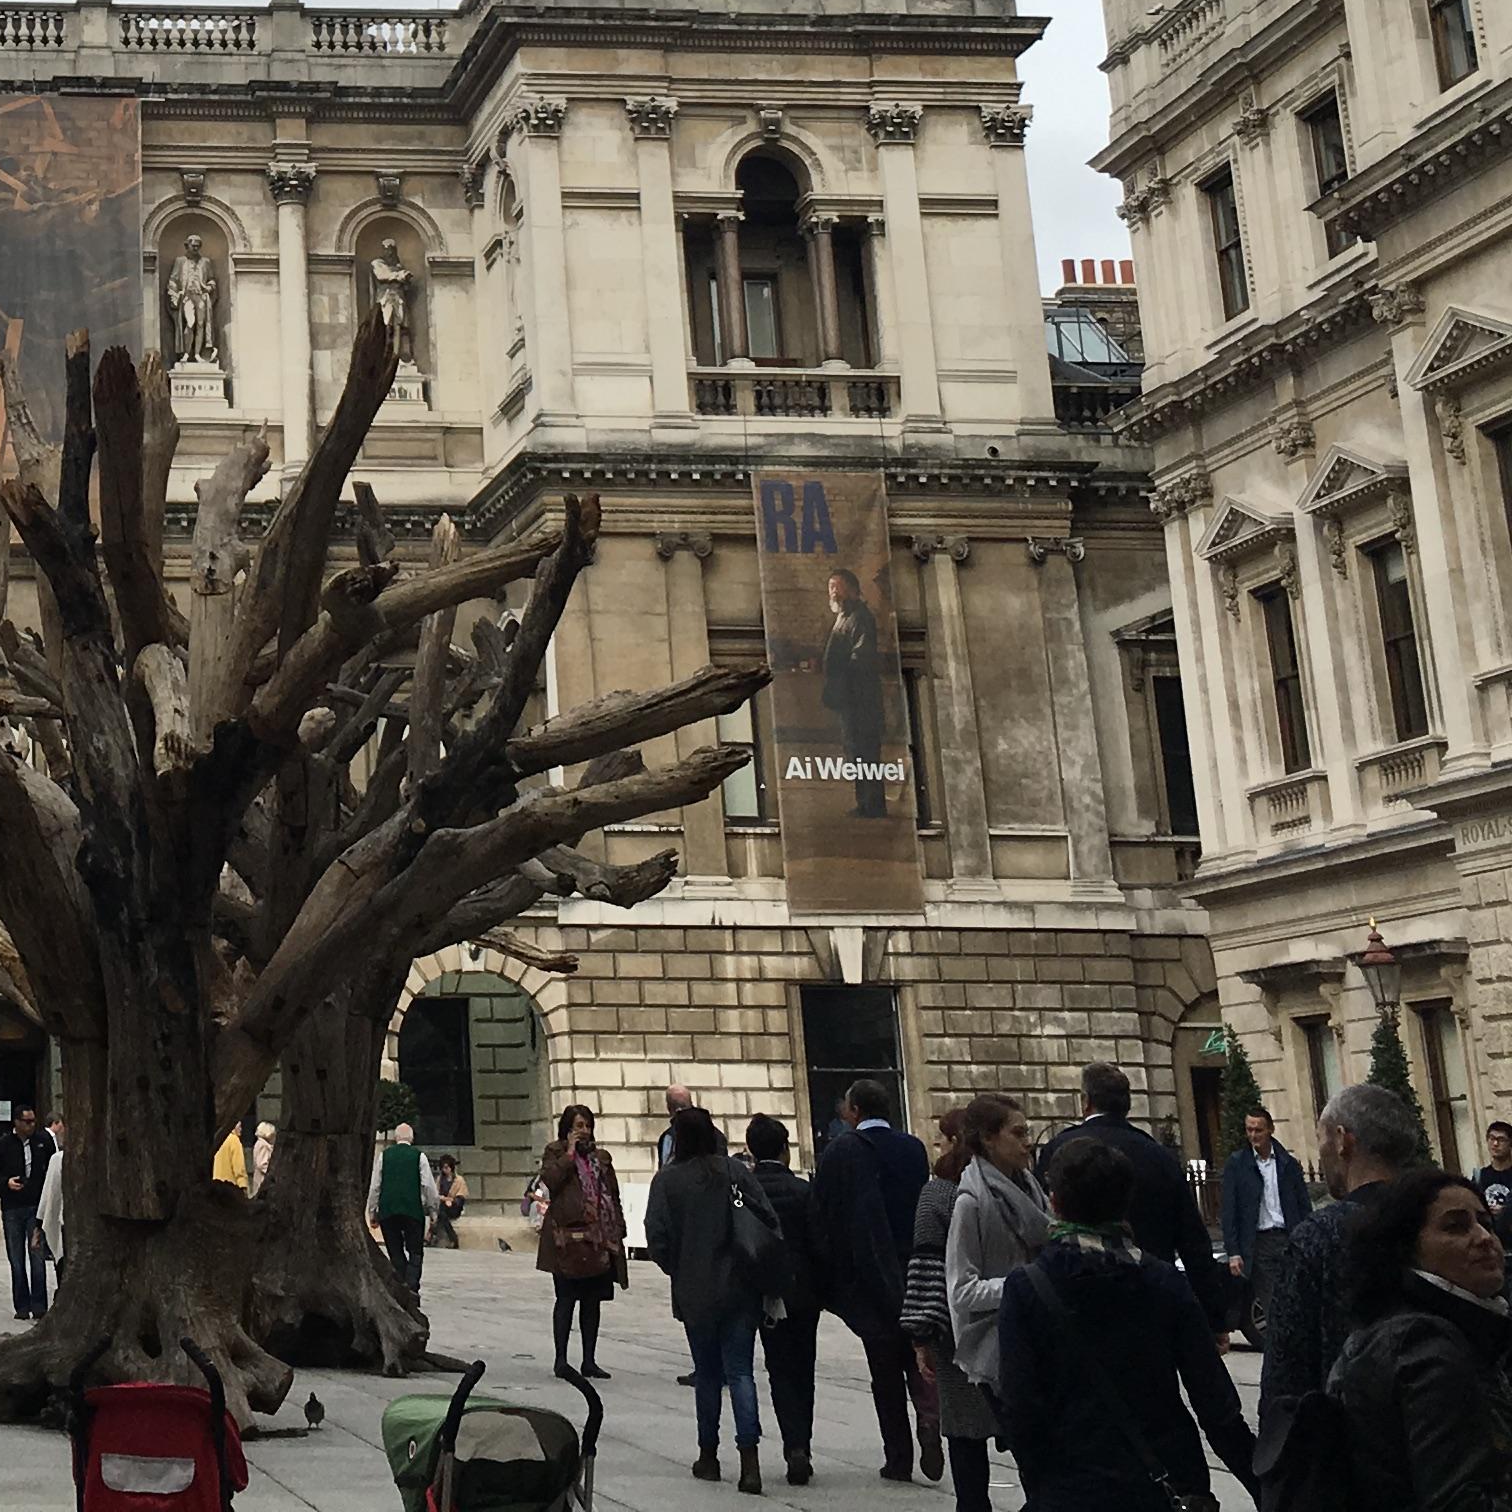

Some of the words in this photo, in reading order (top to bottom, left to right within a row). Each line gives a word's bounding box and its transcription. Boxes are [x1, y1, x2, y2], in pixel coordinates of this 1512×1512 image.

[760, 480, 838, 553] RA
[785, 756, 813, 780] Ai
[814, 756, 905, 781] Weiwei
